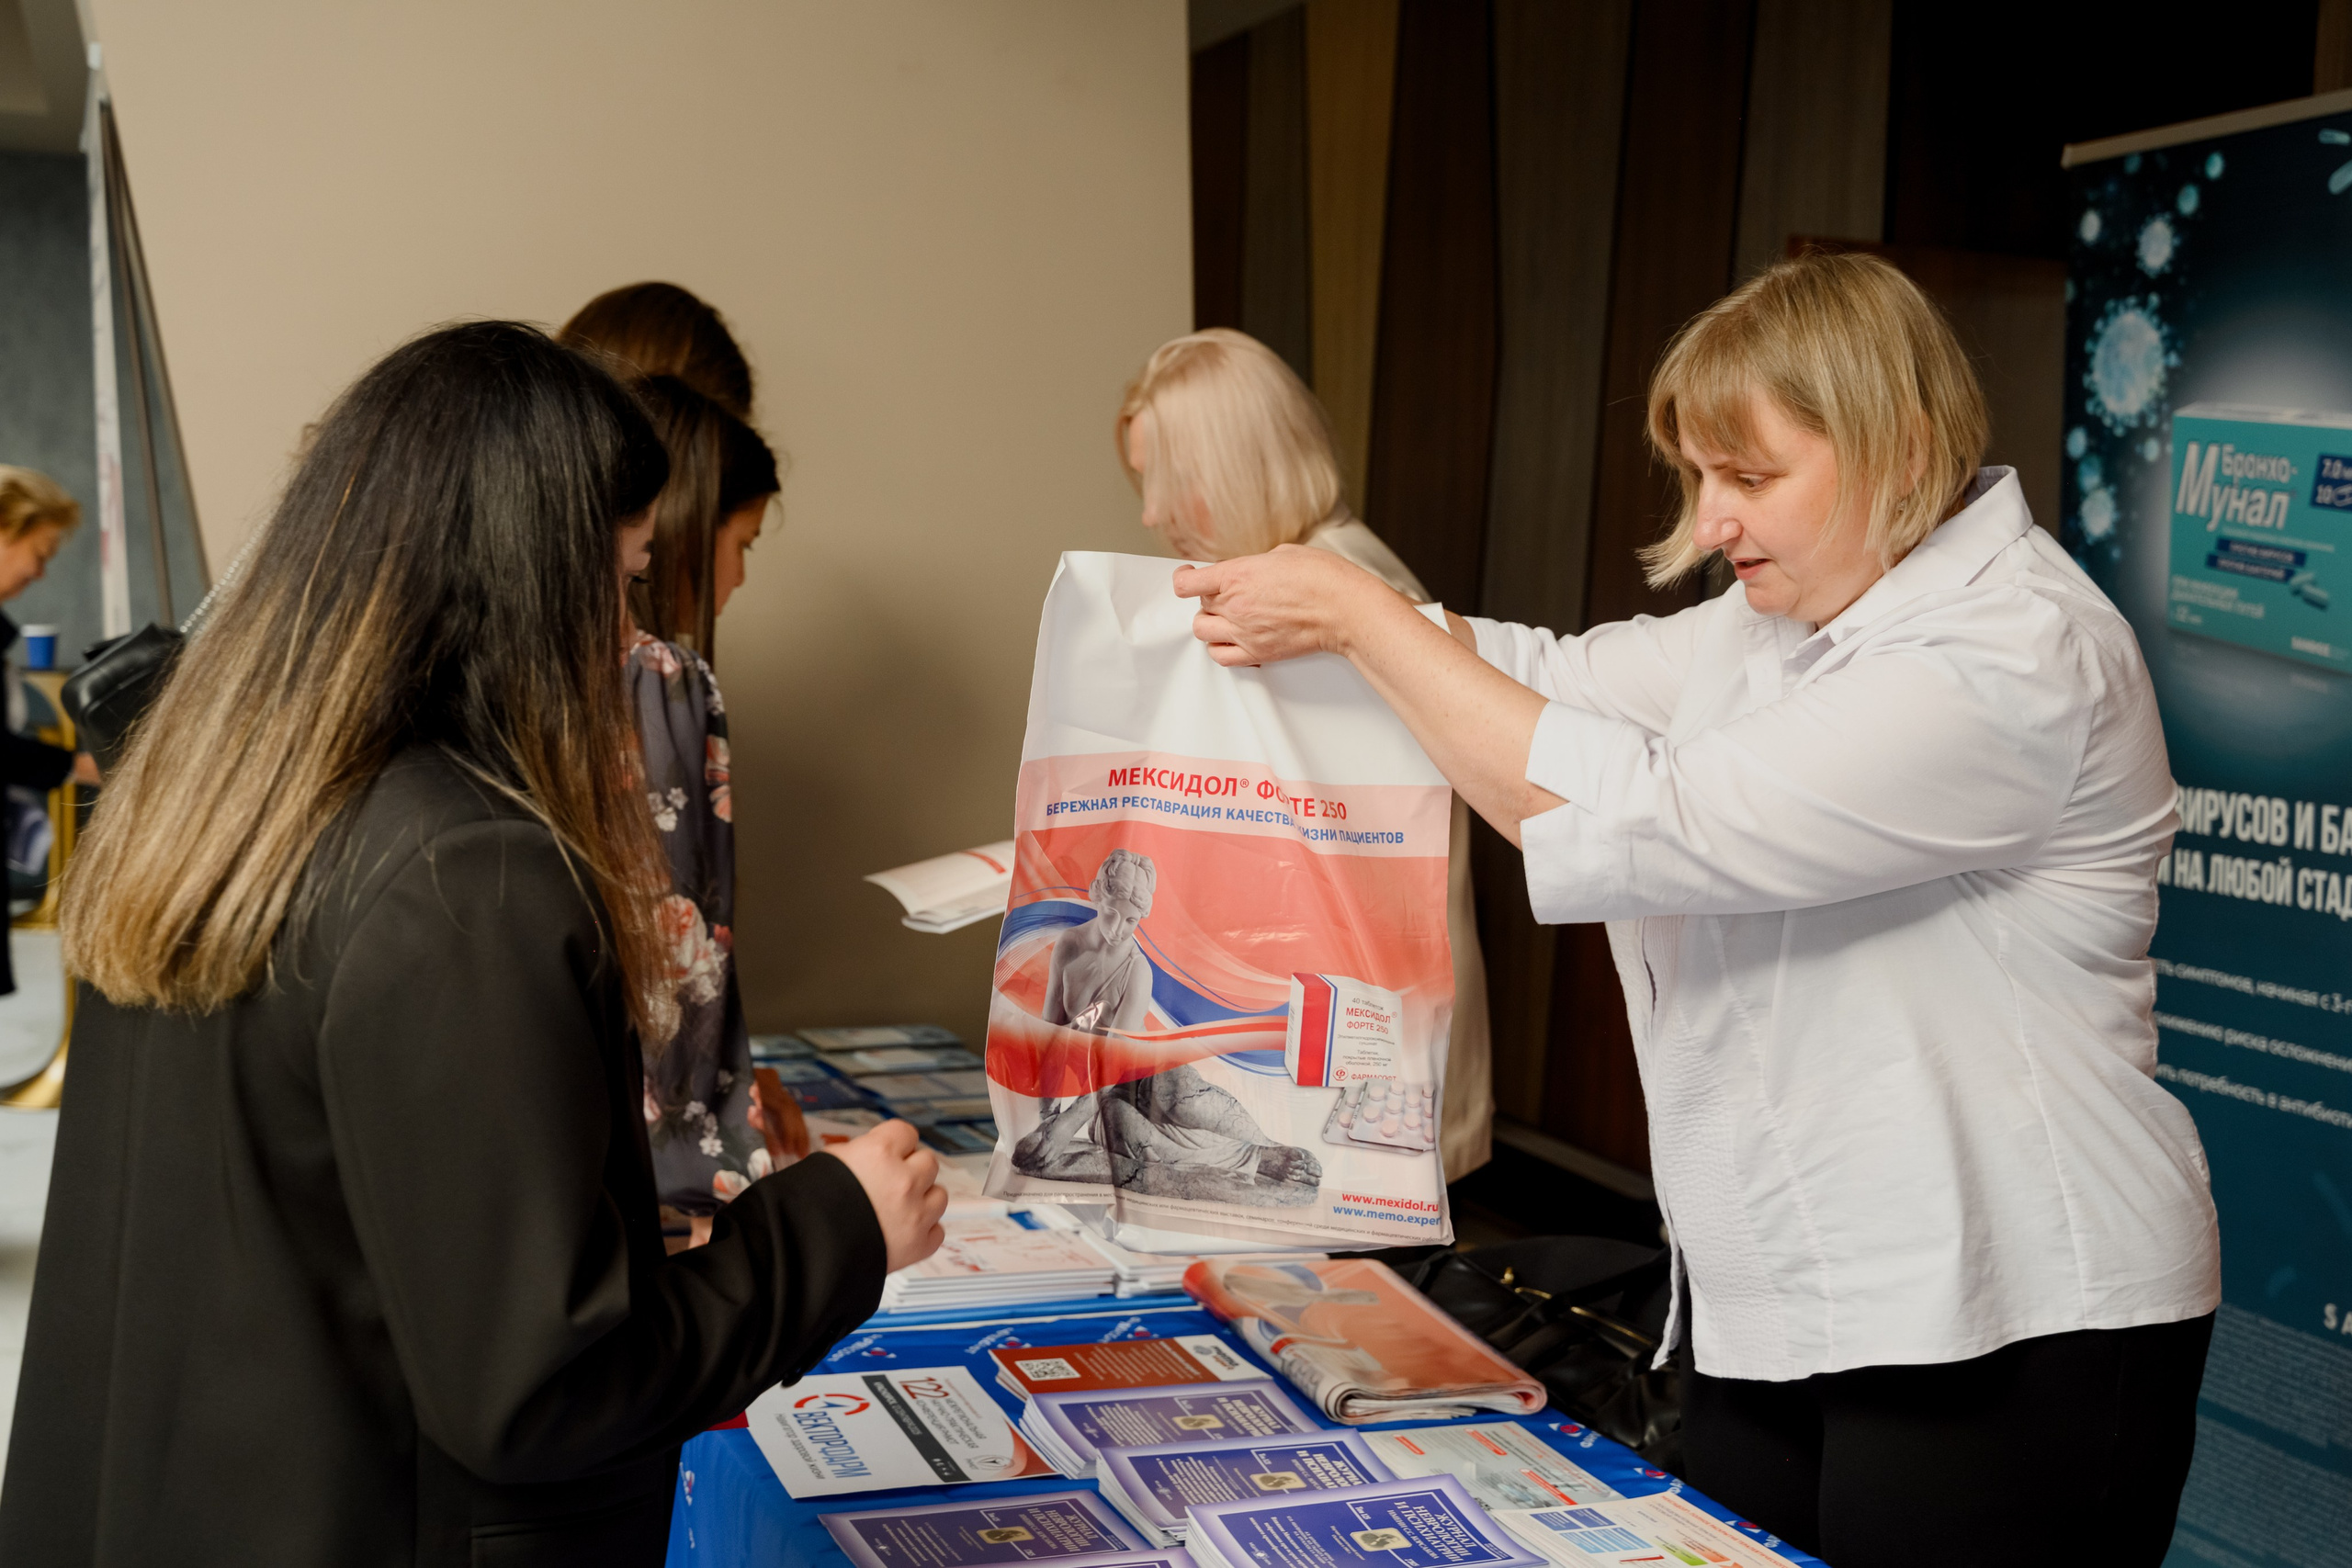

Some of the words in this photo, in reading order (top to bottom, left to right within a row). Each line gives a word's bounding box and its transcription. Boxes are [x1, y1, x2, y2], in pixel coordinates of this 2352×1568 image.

[2222, 443, 2298, 485] Бронхо-
[2176, 441, 2290, 532] Мунал
[1046, 797, 1118, 816] БЕРЕЖНАЯ
[1122, 795, 1222, 819] РЕСТАВРАЦИЯ
[1226, 807, 1295, 828] КАЧЕСТВА
[1340, 829, 1405, 845] ПАЦИЕНТОВ
[1256, 780, 1316, 818] ФОТЕ
[1320, 799, 1348, 820] 250
[2294, 800, 2314, 852] И
[2174, 847, 2205, 892] НА
[2207, 853, 2293, 908] ЛЮБОЙ
[1346, 1021, 1374, 1031] ФОРТЕ
[1376, 1024, 1389, 1034] 250
[1341, 1193, 1439, 1213] www.mexidol.ru
[791, 1411, 872, 1478] ВЕКТОРФАРМ
[1299, 1458, 1341, 1488] ПСИХИАТ
[1308, 1453, 1354, 1486] НЕВРОЛО
[1329, 1460, 1365, 1484] ЖУРНА
[1385, 1509, 1408, 1528] ИМЕНИ
[1399, 1508, 1463, 1562] ПСИХИАТРИИ
[1410, 1505, 1472, 1557] НЕВРОЛОГИИ
[1432, 1512, 1477, 1548] ЖУРНАЛ
